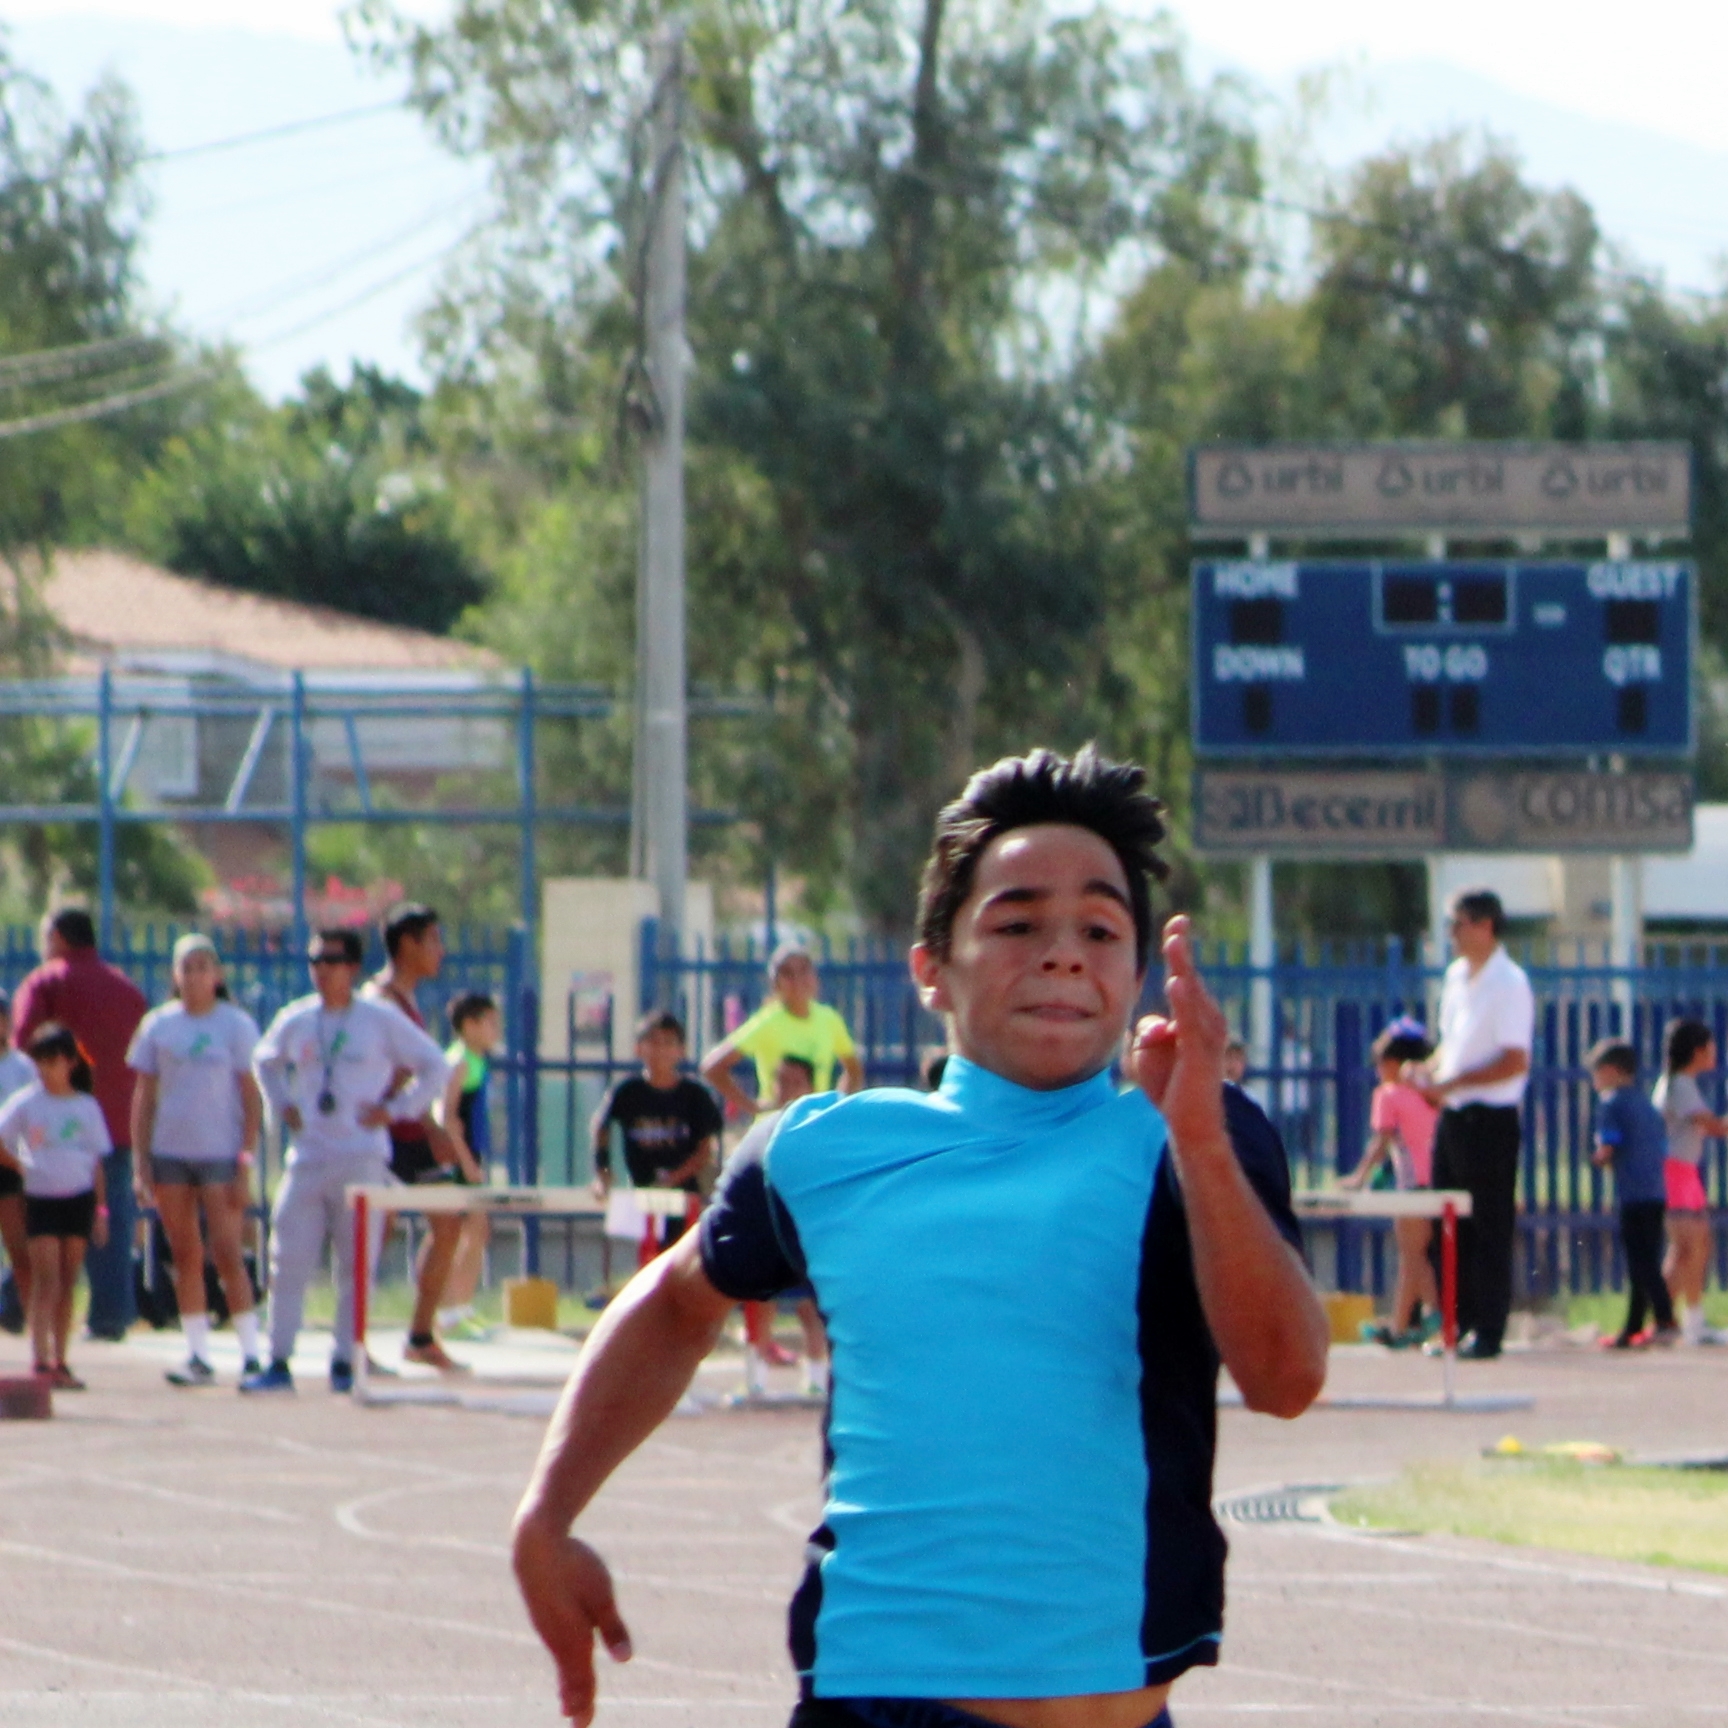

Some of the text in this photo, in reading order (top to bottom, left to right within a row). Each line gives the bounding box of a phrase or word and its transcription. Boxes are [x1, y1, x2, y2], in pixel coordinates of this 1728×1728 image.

[1213, 562, 1298, 598] HOME
[1587, 562, 1678, 598] GUEST
[1213, 644, 1304, 680] DOWN
[1404, 644, 1487, 680] TO GO
[1603, 644, 1661, 684] QTR
